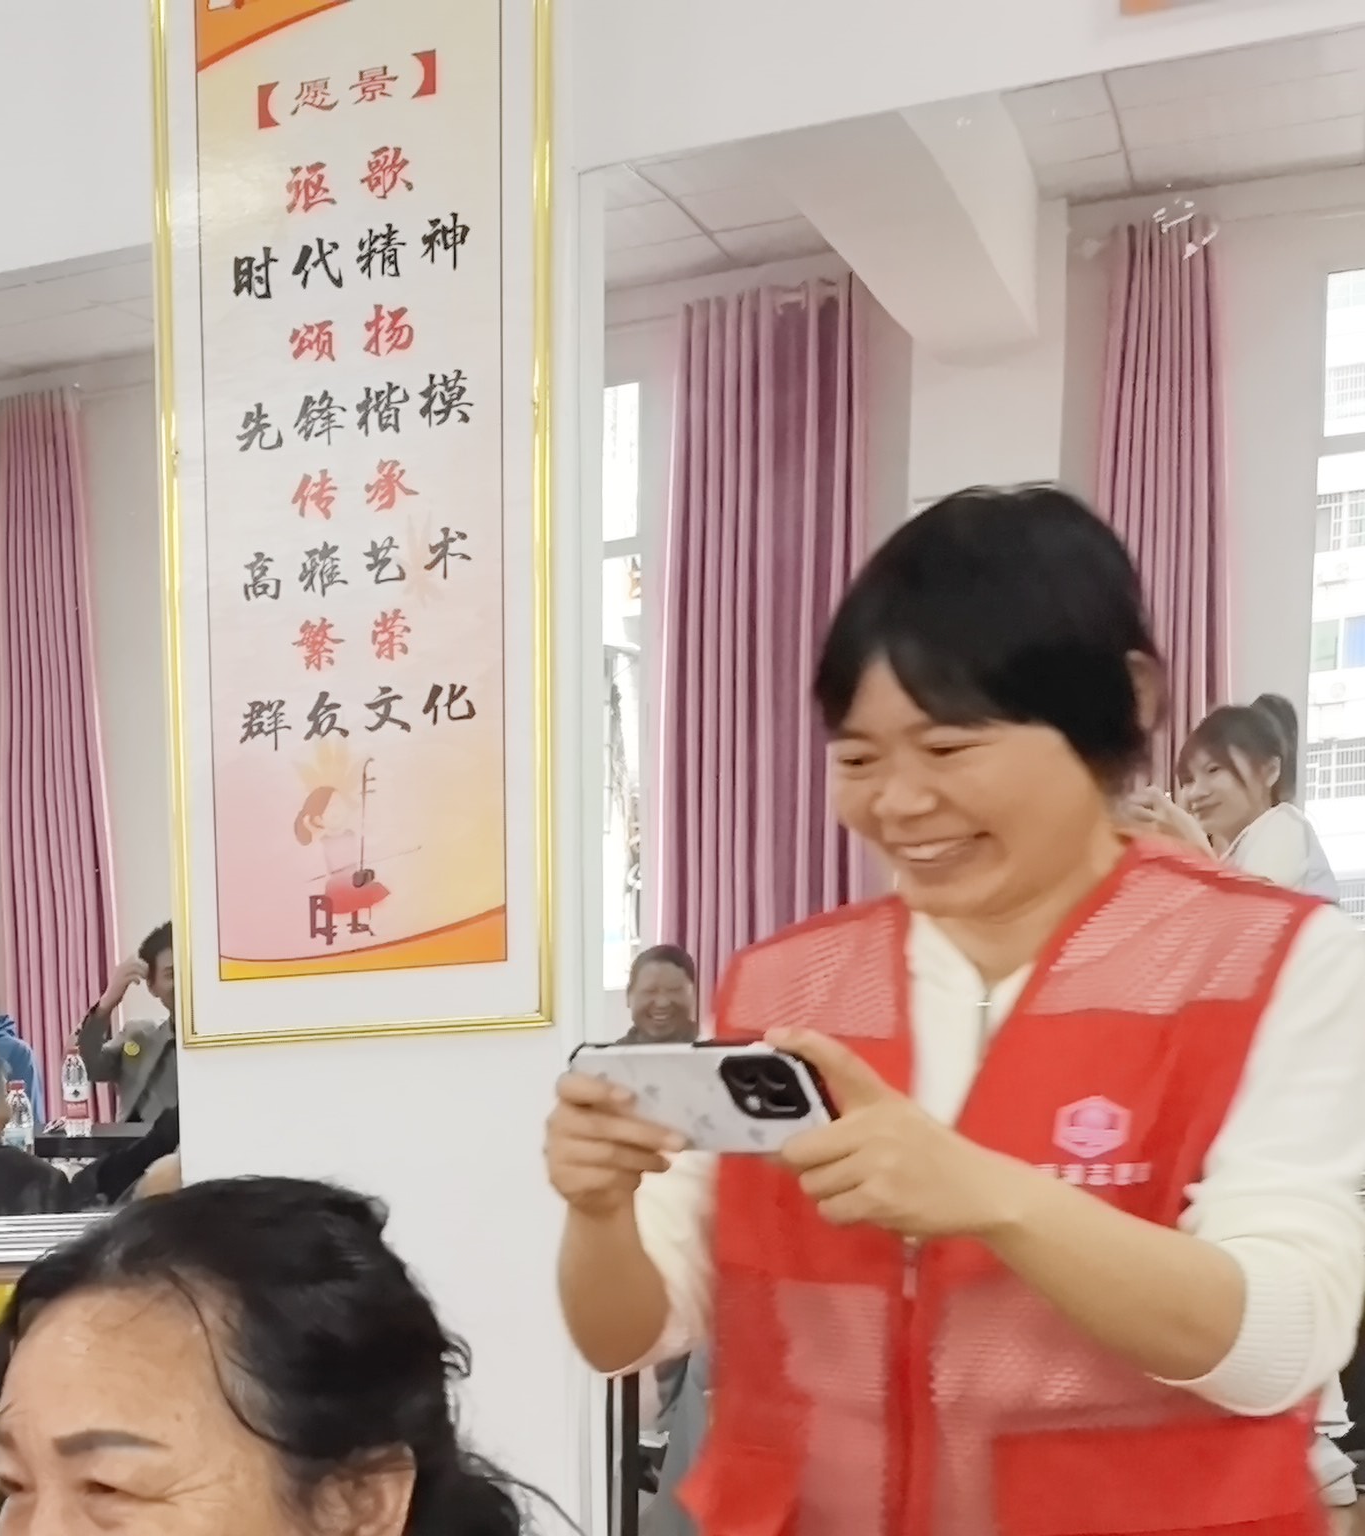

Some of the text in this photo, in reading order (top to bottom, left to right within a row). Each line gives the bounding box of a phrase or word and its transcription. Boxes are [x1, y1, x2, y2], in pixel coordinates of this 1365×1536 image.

[286, 146, 413, 214] 讴歌
[232, 213, 470, 300] 时代精神
[289, 304, 414, 361] 颂扬
[236, 369, 474, 452] 先锋楷模
[291, 458, 419, 519] 传承
[242, 526, 472, 601] 高雅艺术
[291, 608, 411, 670] 繁荣
[239, 683, 476, 751] 群众文化
